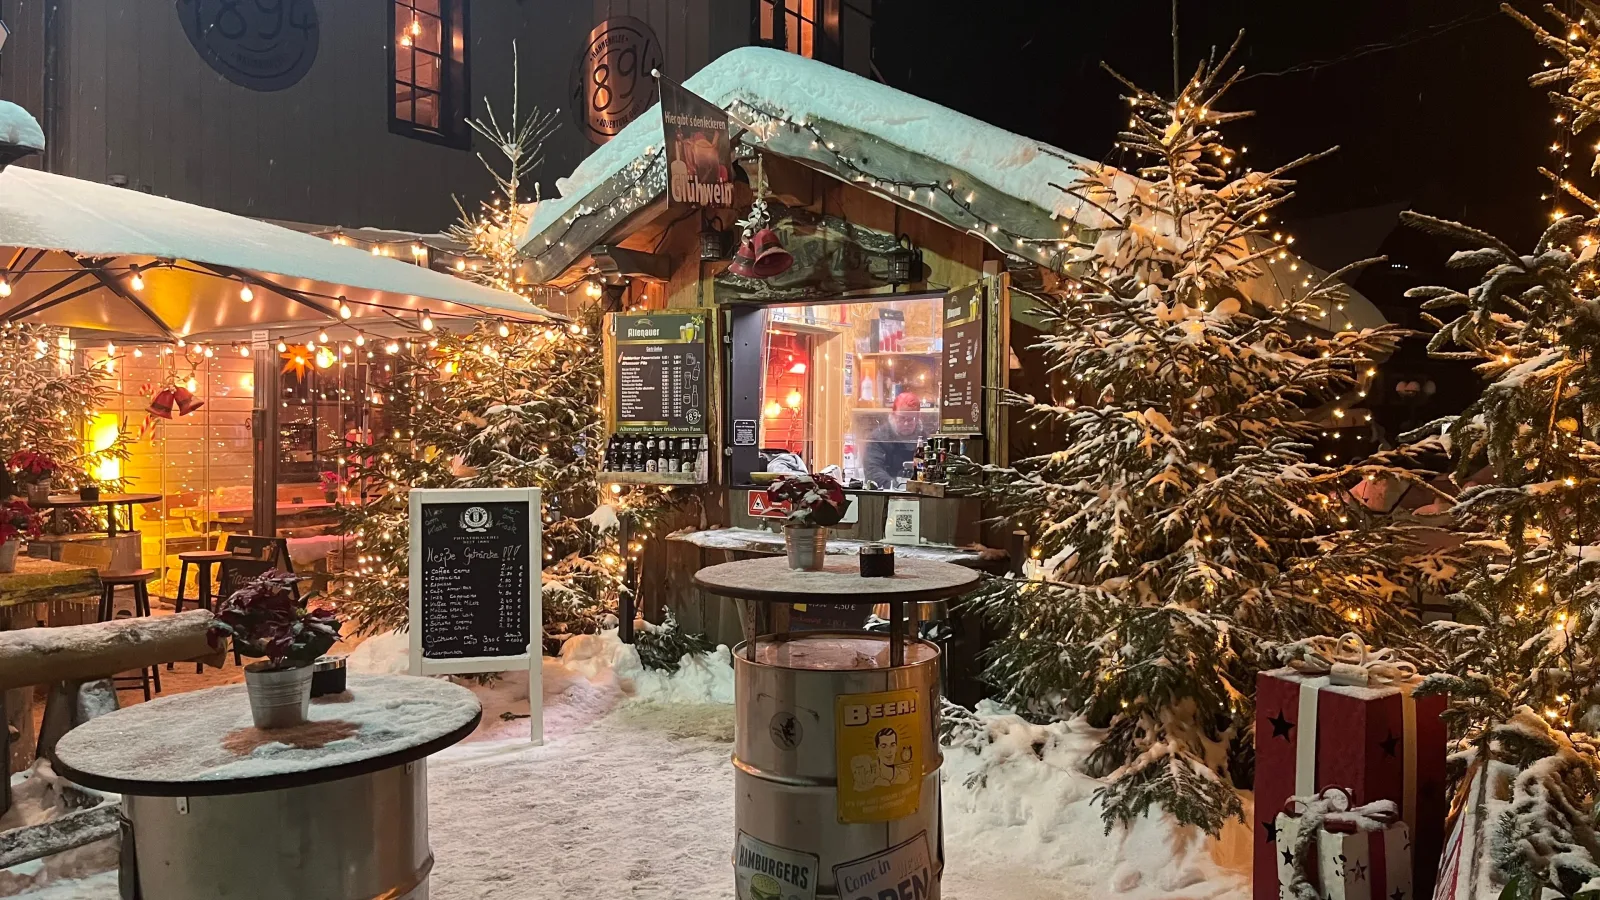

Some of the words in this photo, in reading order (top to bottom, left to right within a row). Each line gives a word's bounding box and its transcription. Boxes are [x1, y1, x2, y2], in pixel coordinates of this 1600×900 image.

[664, 110, 677, 125] Hier
[703, 115, 726, 130] leckeren
[671, 174, 734, 206] Glühwein
[628, 328, 660, 338] Altenauer
[844, 700, 916, 726] BEER!
[739, 844, 809, 890] HAMBURGERS
[844, 870, 878, 893] Come
[878, 860, 891, 876] in
[856, 867, 929, 900] EN
